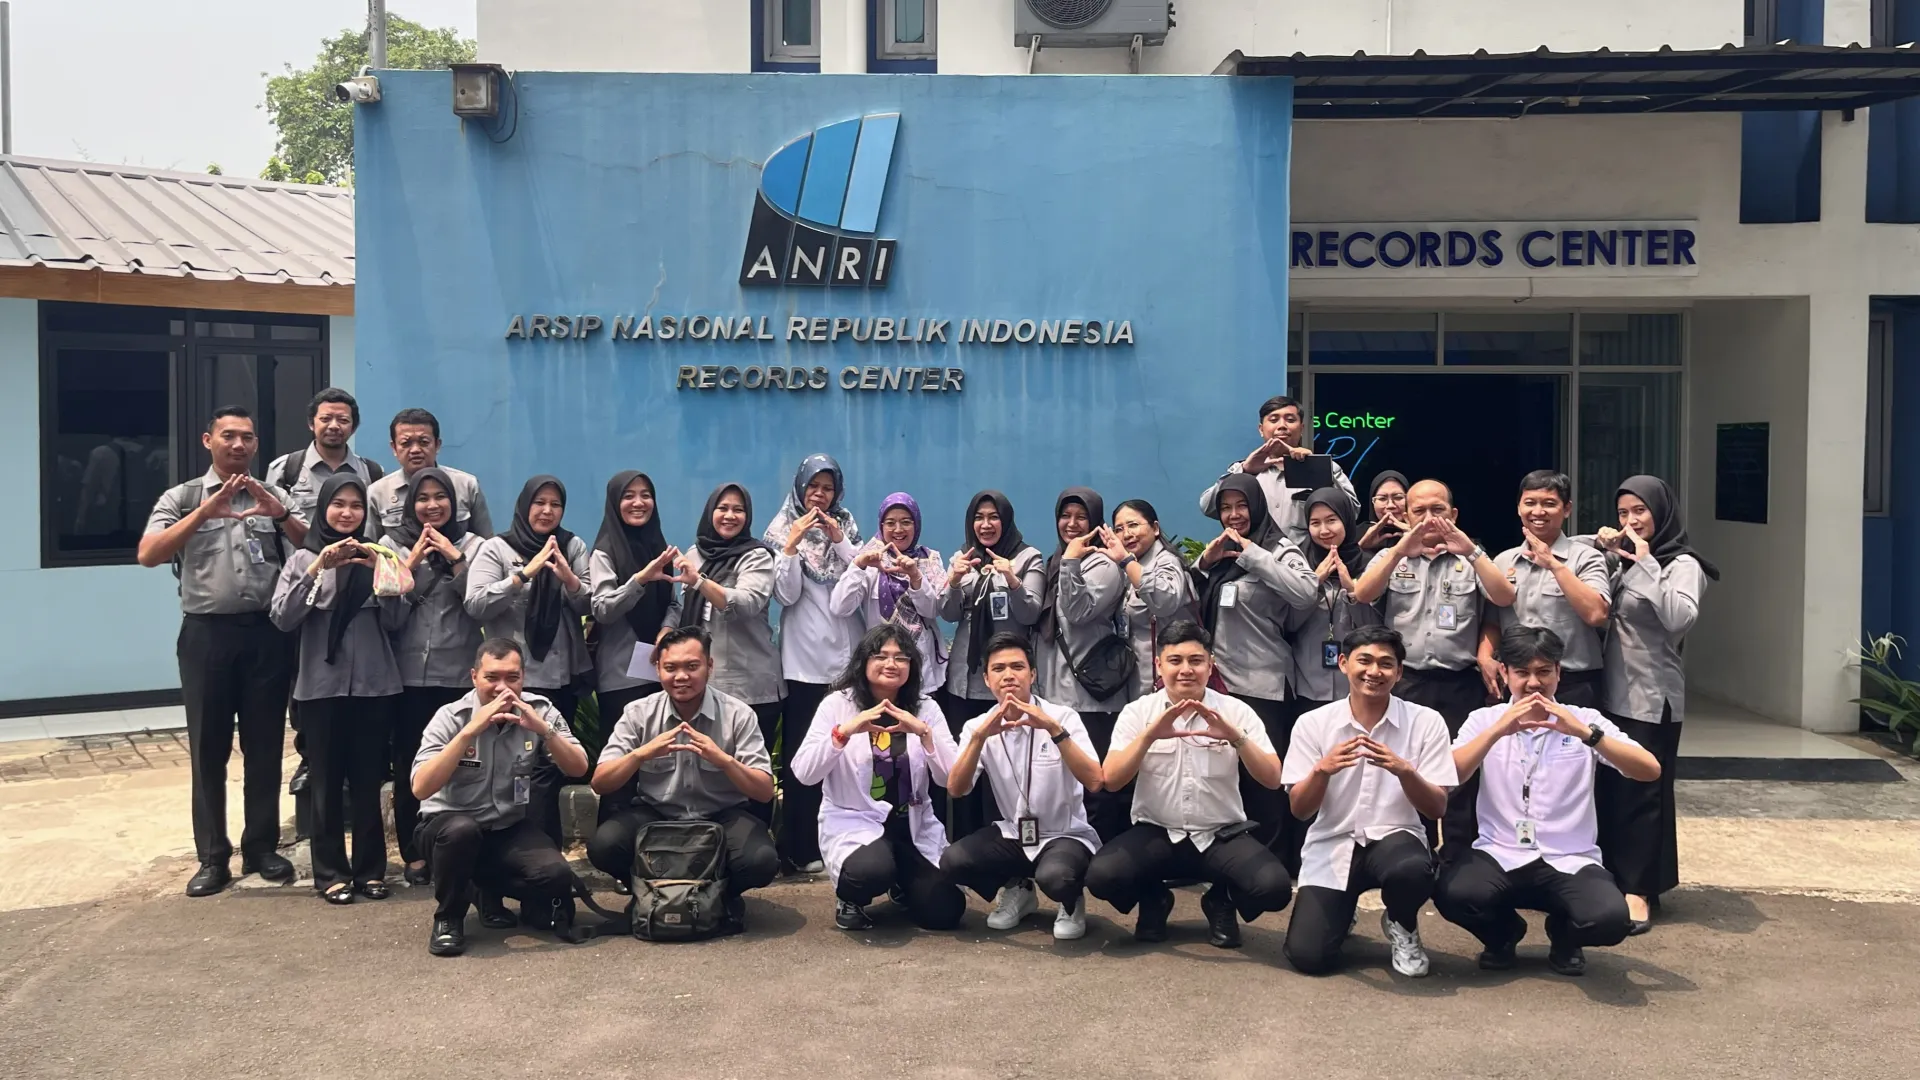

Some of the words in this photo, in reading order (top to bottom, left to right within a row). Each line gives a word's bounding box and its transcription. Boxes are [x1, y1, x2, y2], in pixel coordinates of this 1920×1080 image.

[746, 244, 888, 281] ANRI
[1289, 230, 1503, 268] RECORDS
[1518, 229, 1697, 268] CENTER
[504, 314, 603, 340] ARSIP
[610, 314, 775, 341] NASIONAL
[785, 315, 951, 343] REPUBLIK
[957, 318, 1134, 345] INDONESIA
[675, 364, 828, 390] RECORDS
[838, 365, 965, 392] CENTER
[1325, 411, 1395, 429] Center
